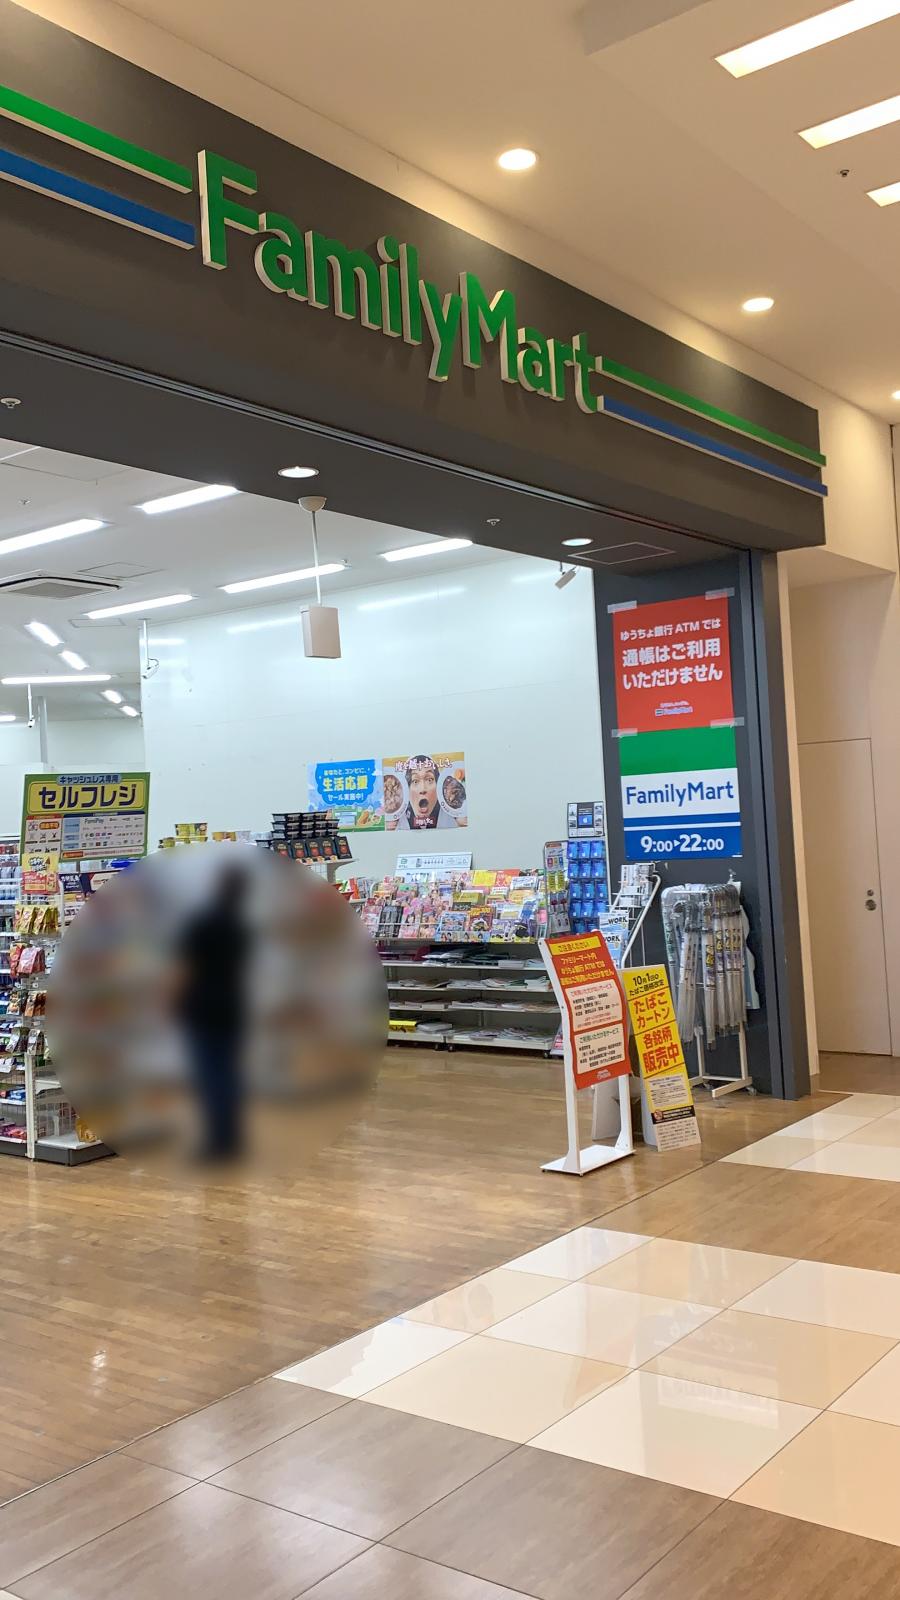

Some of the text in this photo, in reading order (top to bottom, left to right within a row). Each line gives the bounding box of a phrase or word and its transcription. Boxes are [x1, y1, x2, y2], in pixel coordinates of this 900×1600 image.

[198, 150, 599, 414] FamilyMart
[620, 618, 721, 641] ゆうちょ銀行 ATM では
[622, 638, 721, 667] 通帳はご利用
[623, 663, 723, 690] いただけません
[322, 775, 369, 792] 生活応援
[626, 781, 734, 807] FamilyMart
[38, 784, 137, 810] セルフレジ
[640, 834, 725, 853] 9:00 22:00
[633, 991, 668, 1014] たばこ
[636, 1007, 671, 1030] カートン
[643, 1026, 674, 1049] 各銘柄
[642, 1042, 681, 1074] 販売中
